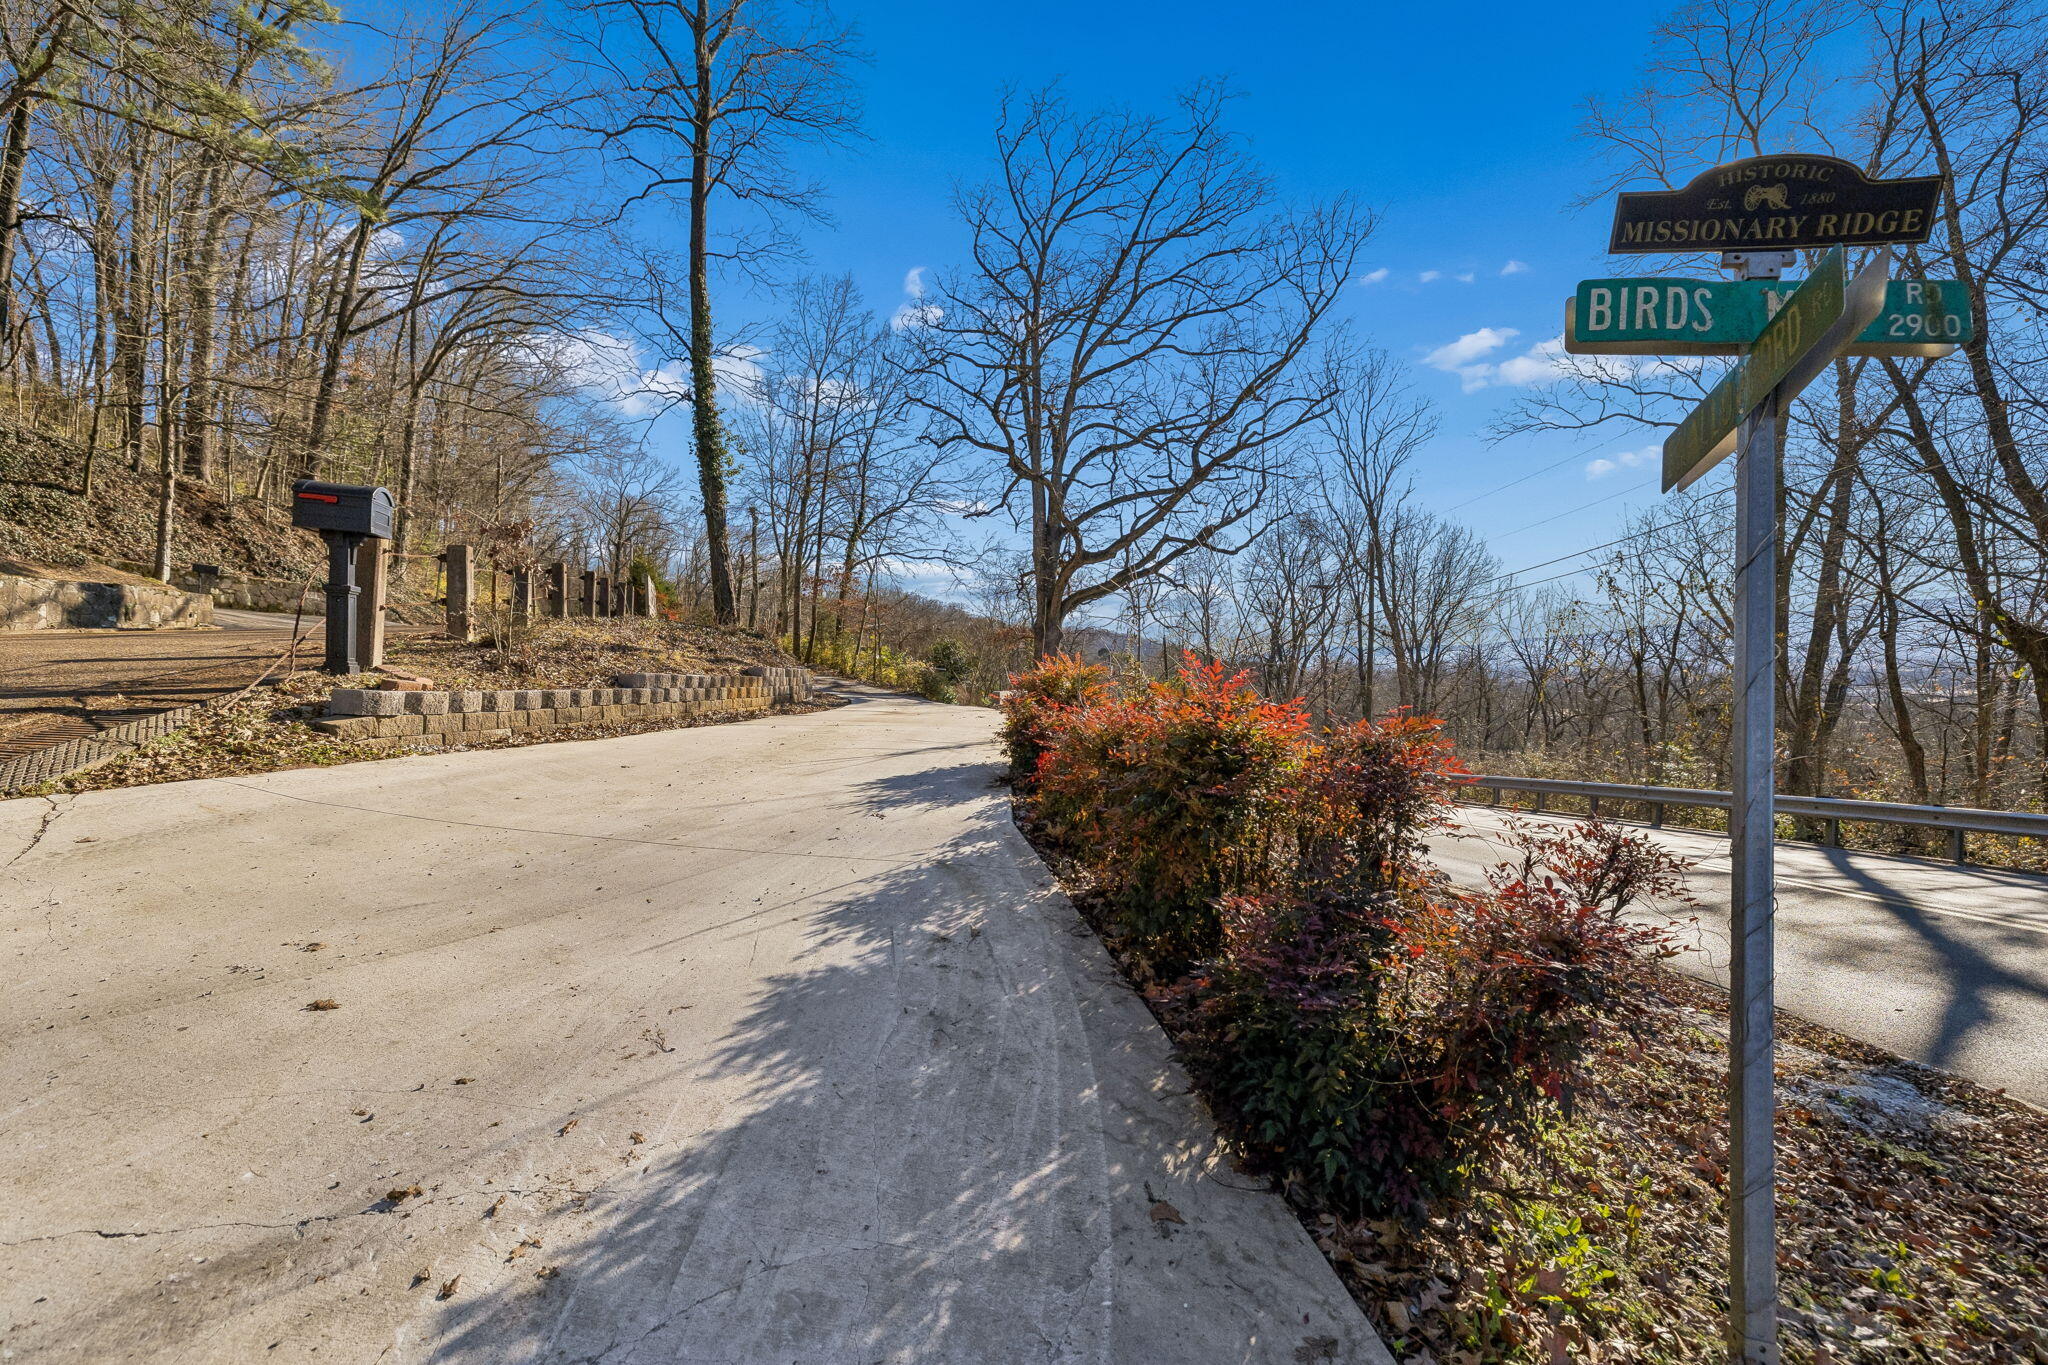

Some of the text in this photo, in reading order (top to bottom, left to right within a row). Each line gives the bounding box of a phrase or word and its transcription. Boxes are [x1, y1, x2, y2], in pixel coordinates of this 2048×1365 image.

[1719, 163, 1834, 187] HISTORIC
[1800, 191, 1836, 205] 1880
[1621, 208, 1924, 243] MISSIONARY RIDGE
[1588, 283, 1942, 332] BIRDS RD
[1888, 313, 1961, 337] 2900
